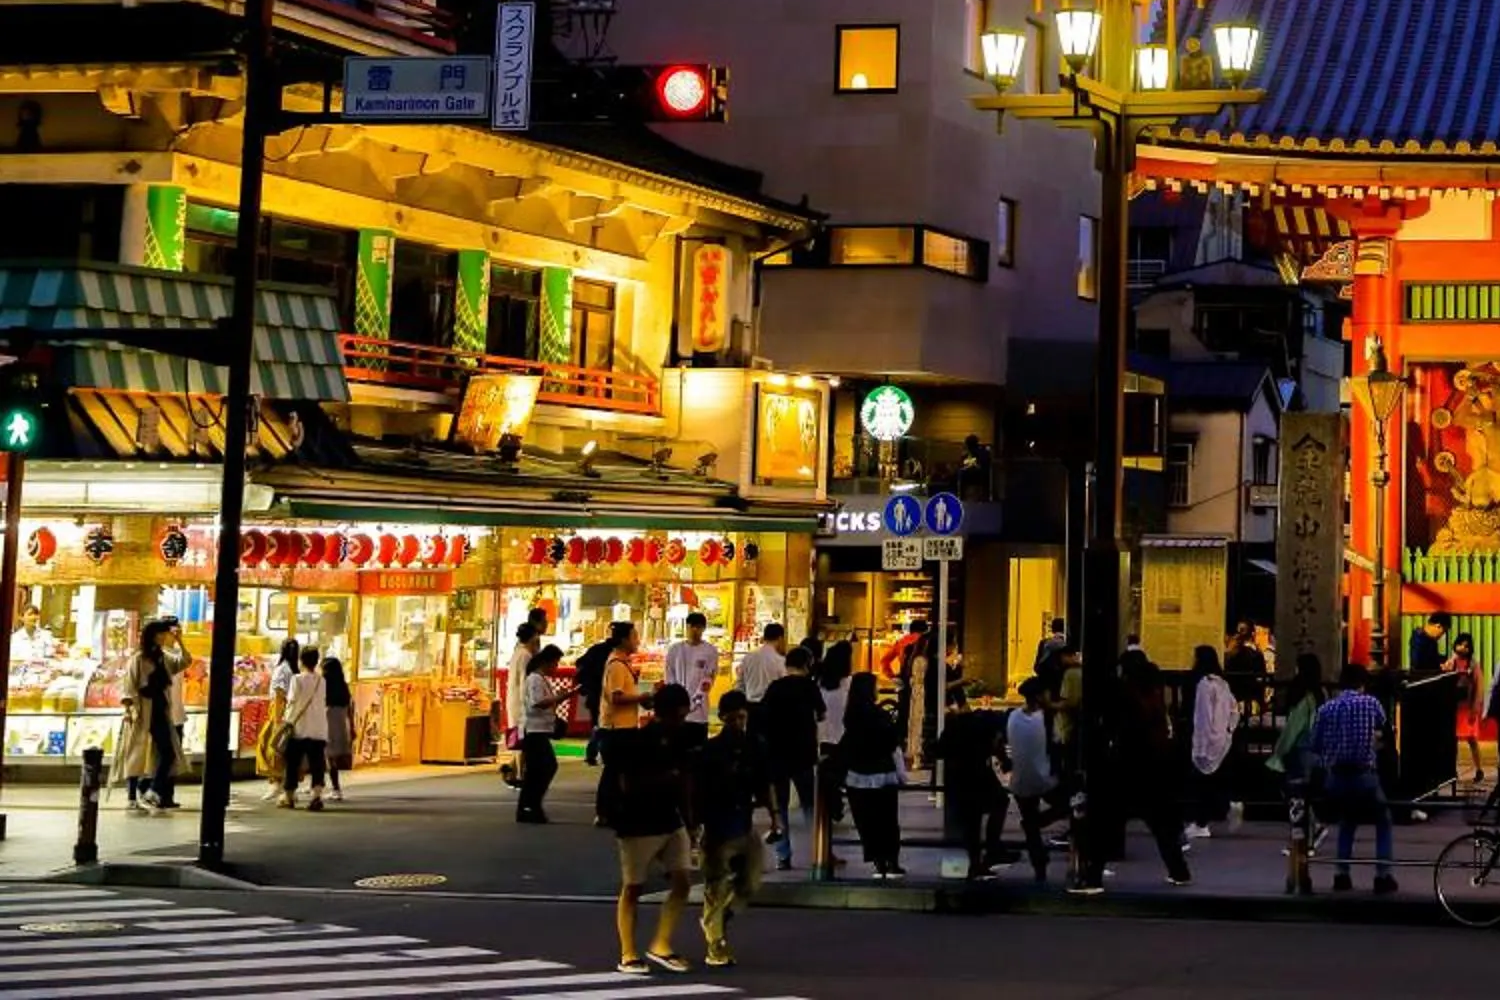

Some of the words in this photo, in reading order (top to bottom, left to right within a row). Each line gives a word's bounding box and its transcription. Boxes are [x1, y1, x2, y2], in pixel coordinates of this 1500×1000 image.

[367, 64, 466, 91] 雷門
[501, 8, 525, 125] スクランブル式
[355, 96, 439, 112] Kaminarimon
[445, 96, 475, 111] Gate
